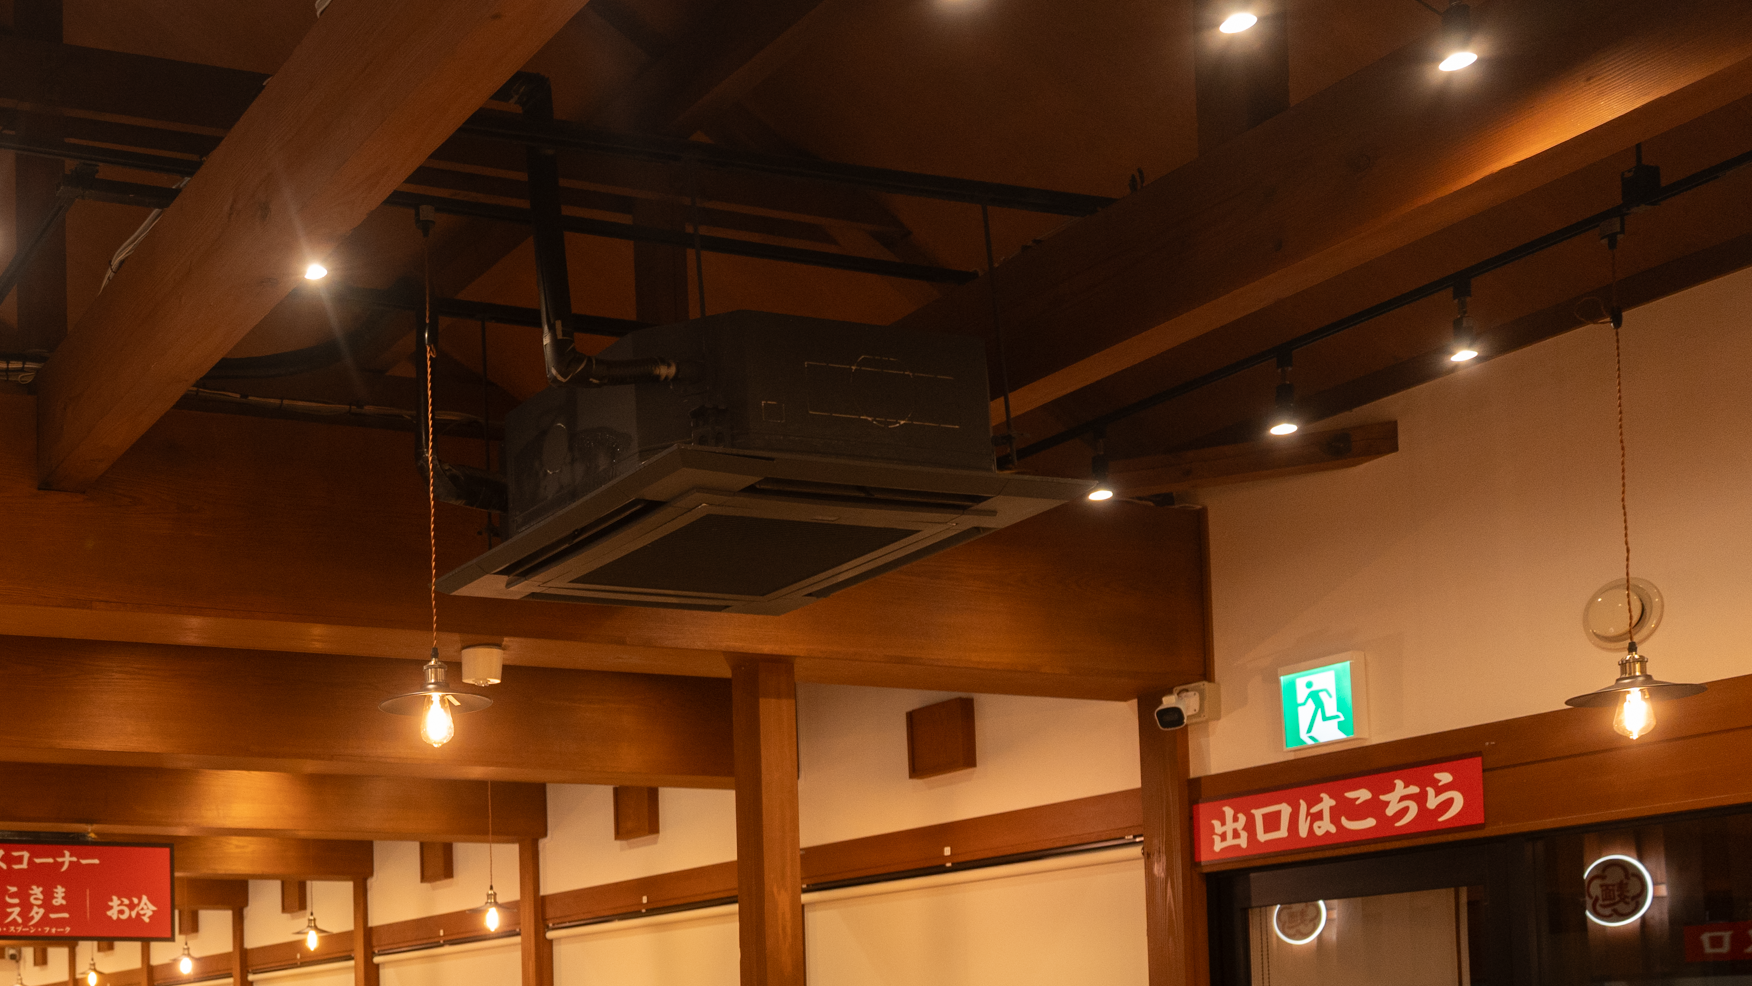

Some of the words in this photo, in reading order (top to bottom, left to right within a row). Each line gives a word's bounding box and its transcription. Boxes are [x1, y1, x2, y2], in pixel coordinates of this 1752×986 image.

[1210, 771, 1465, 852] 出口はこちら
[106, 895, 158, 923] お冷
